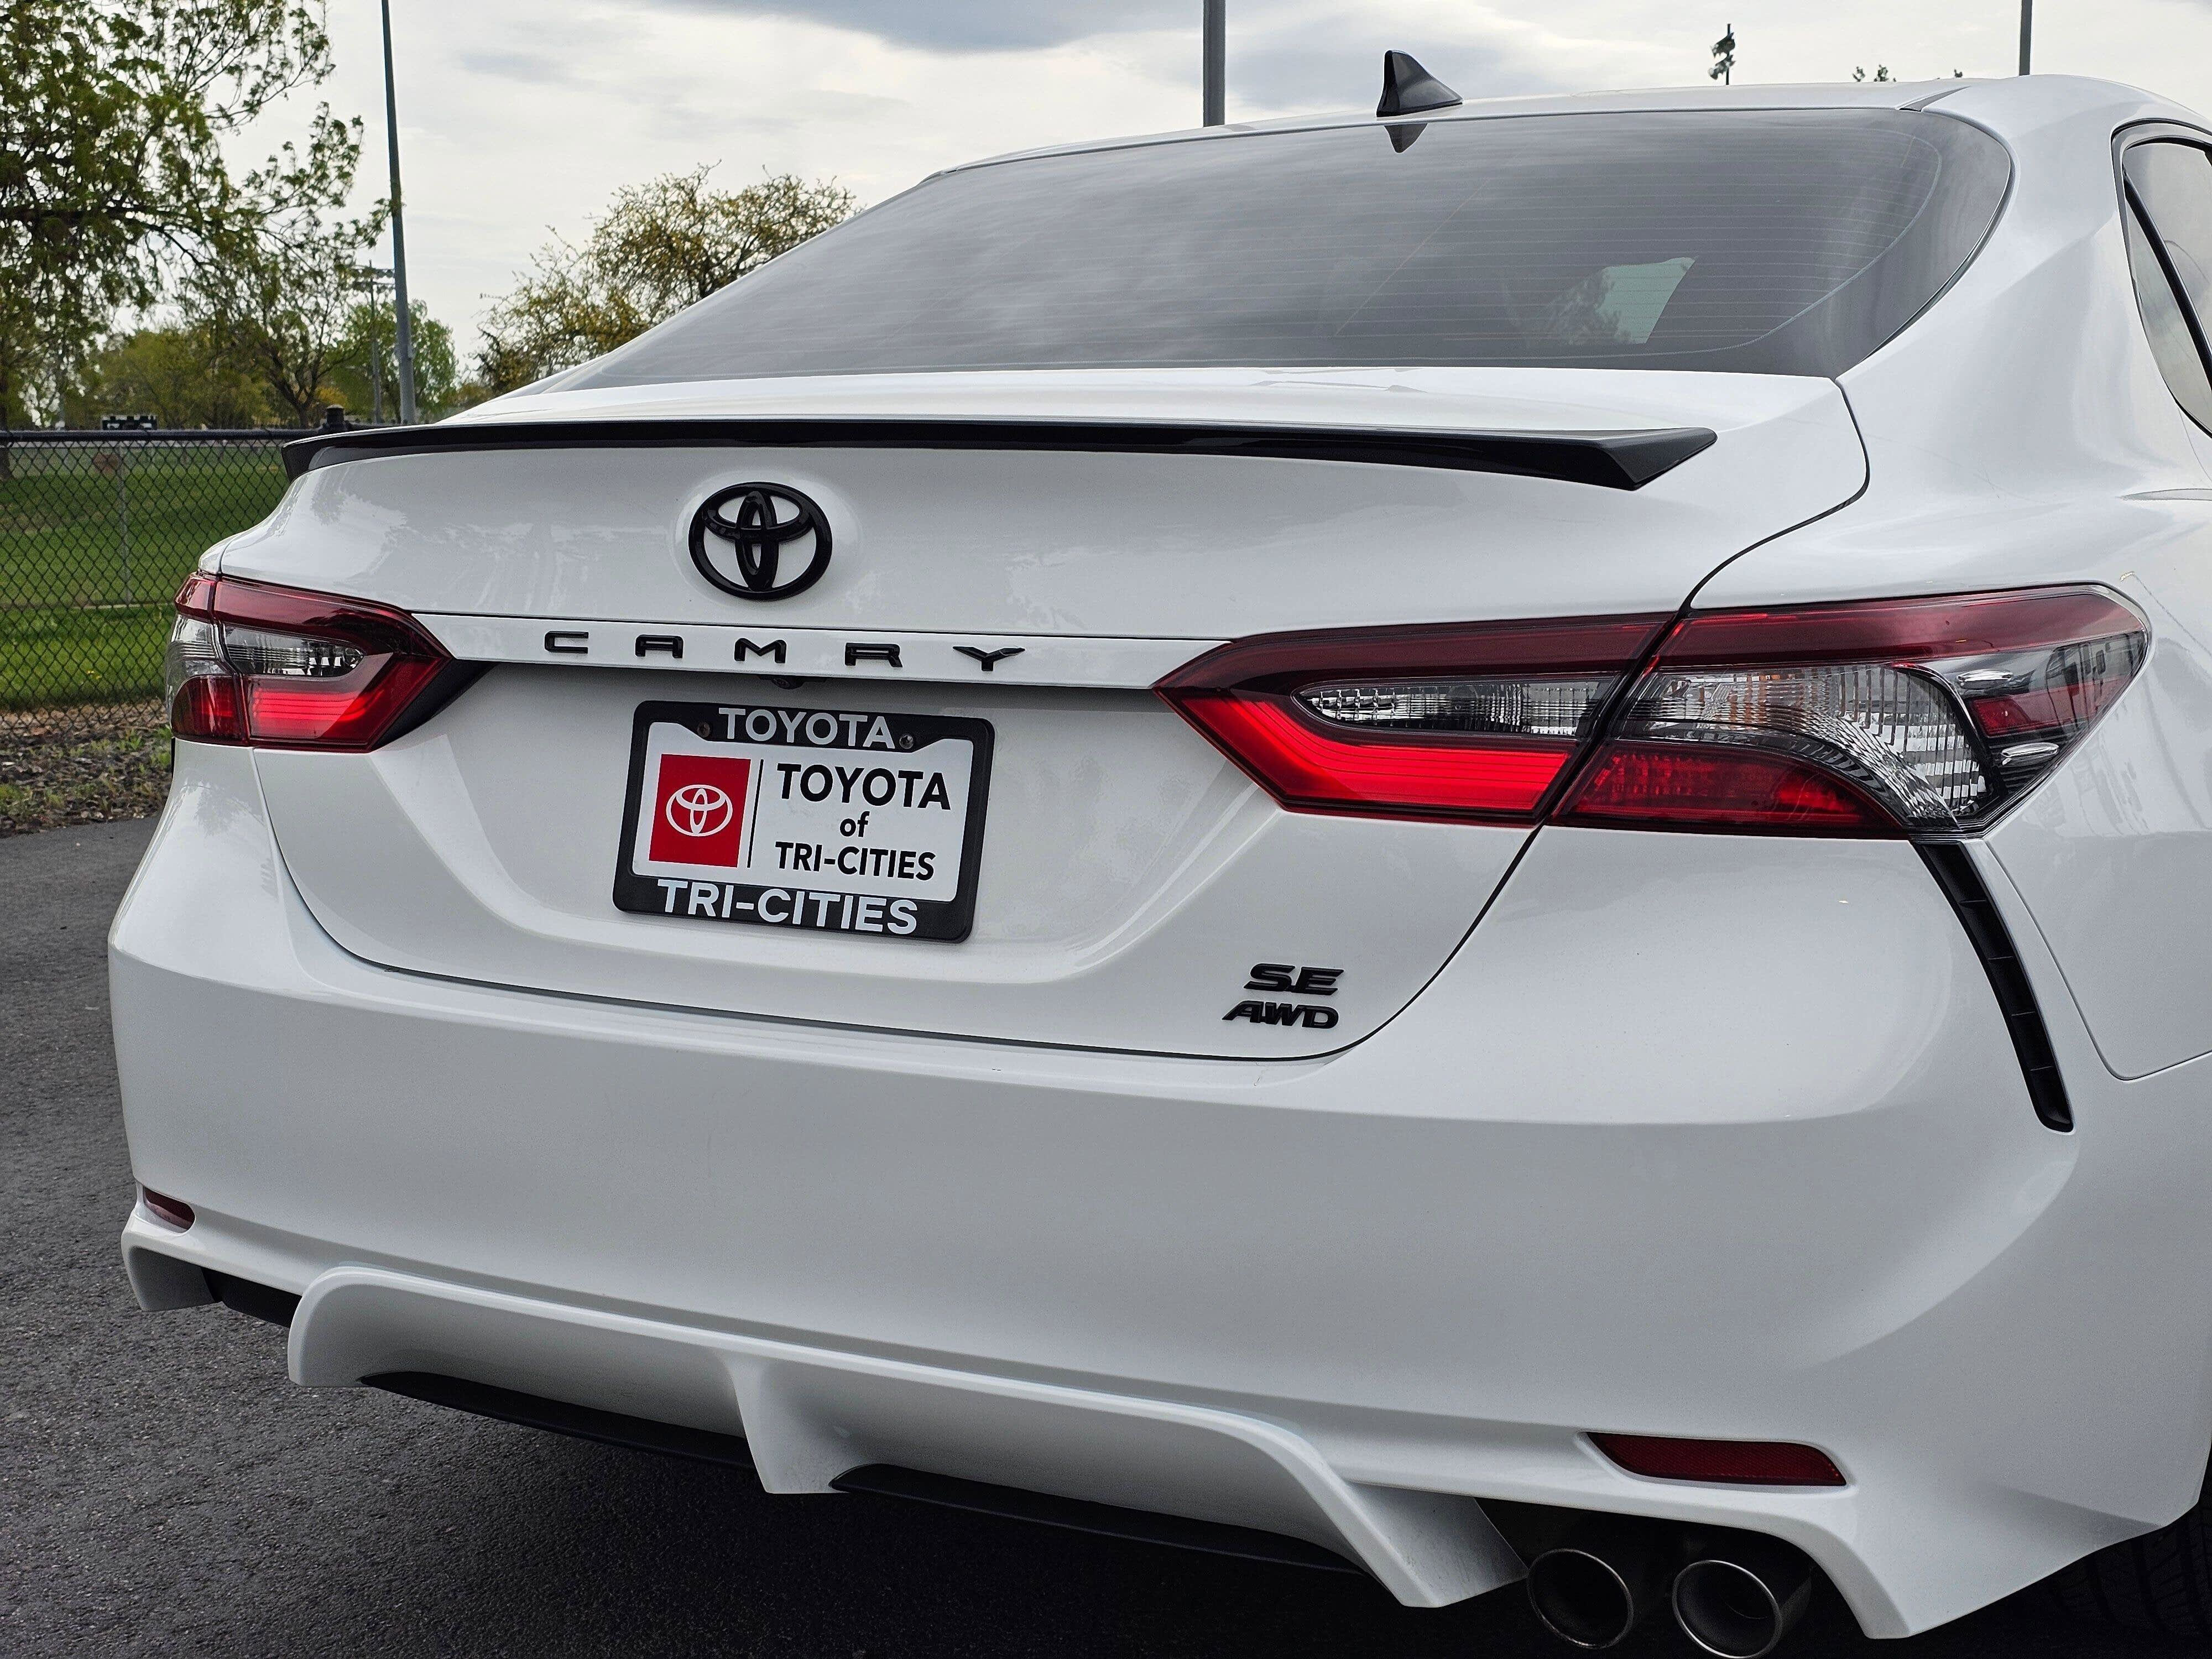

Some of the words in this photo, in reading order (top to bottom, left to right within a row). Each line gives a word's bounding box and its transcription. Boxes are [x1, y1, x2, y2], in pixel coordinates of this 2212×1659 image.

[544, 630, 1025, 671] CAMRY
[719, 707, 895, 749] TOYOTA
[776, 763, 951, 810] TOYOTA
[839, 811, 870, 837] of
[775, 842, 936, 881] TRI-CITIES
[658, 879, 918, 935] TRI-CITIES
[1244, 963, 1344, 995] SE
[1222, 1000, 1339, 1029] AWD
